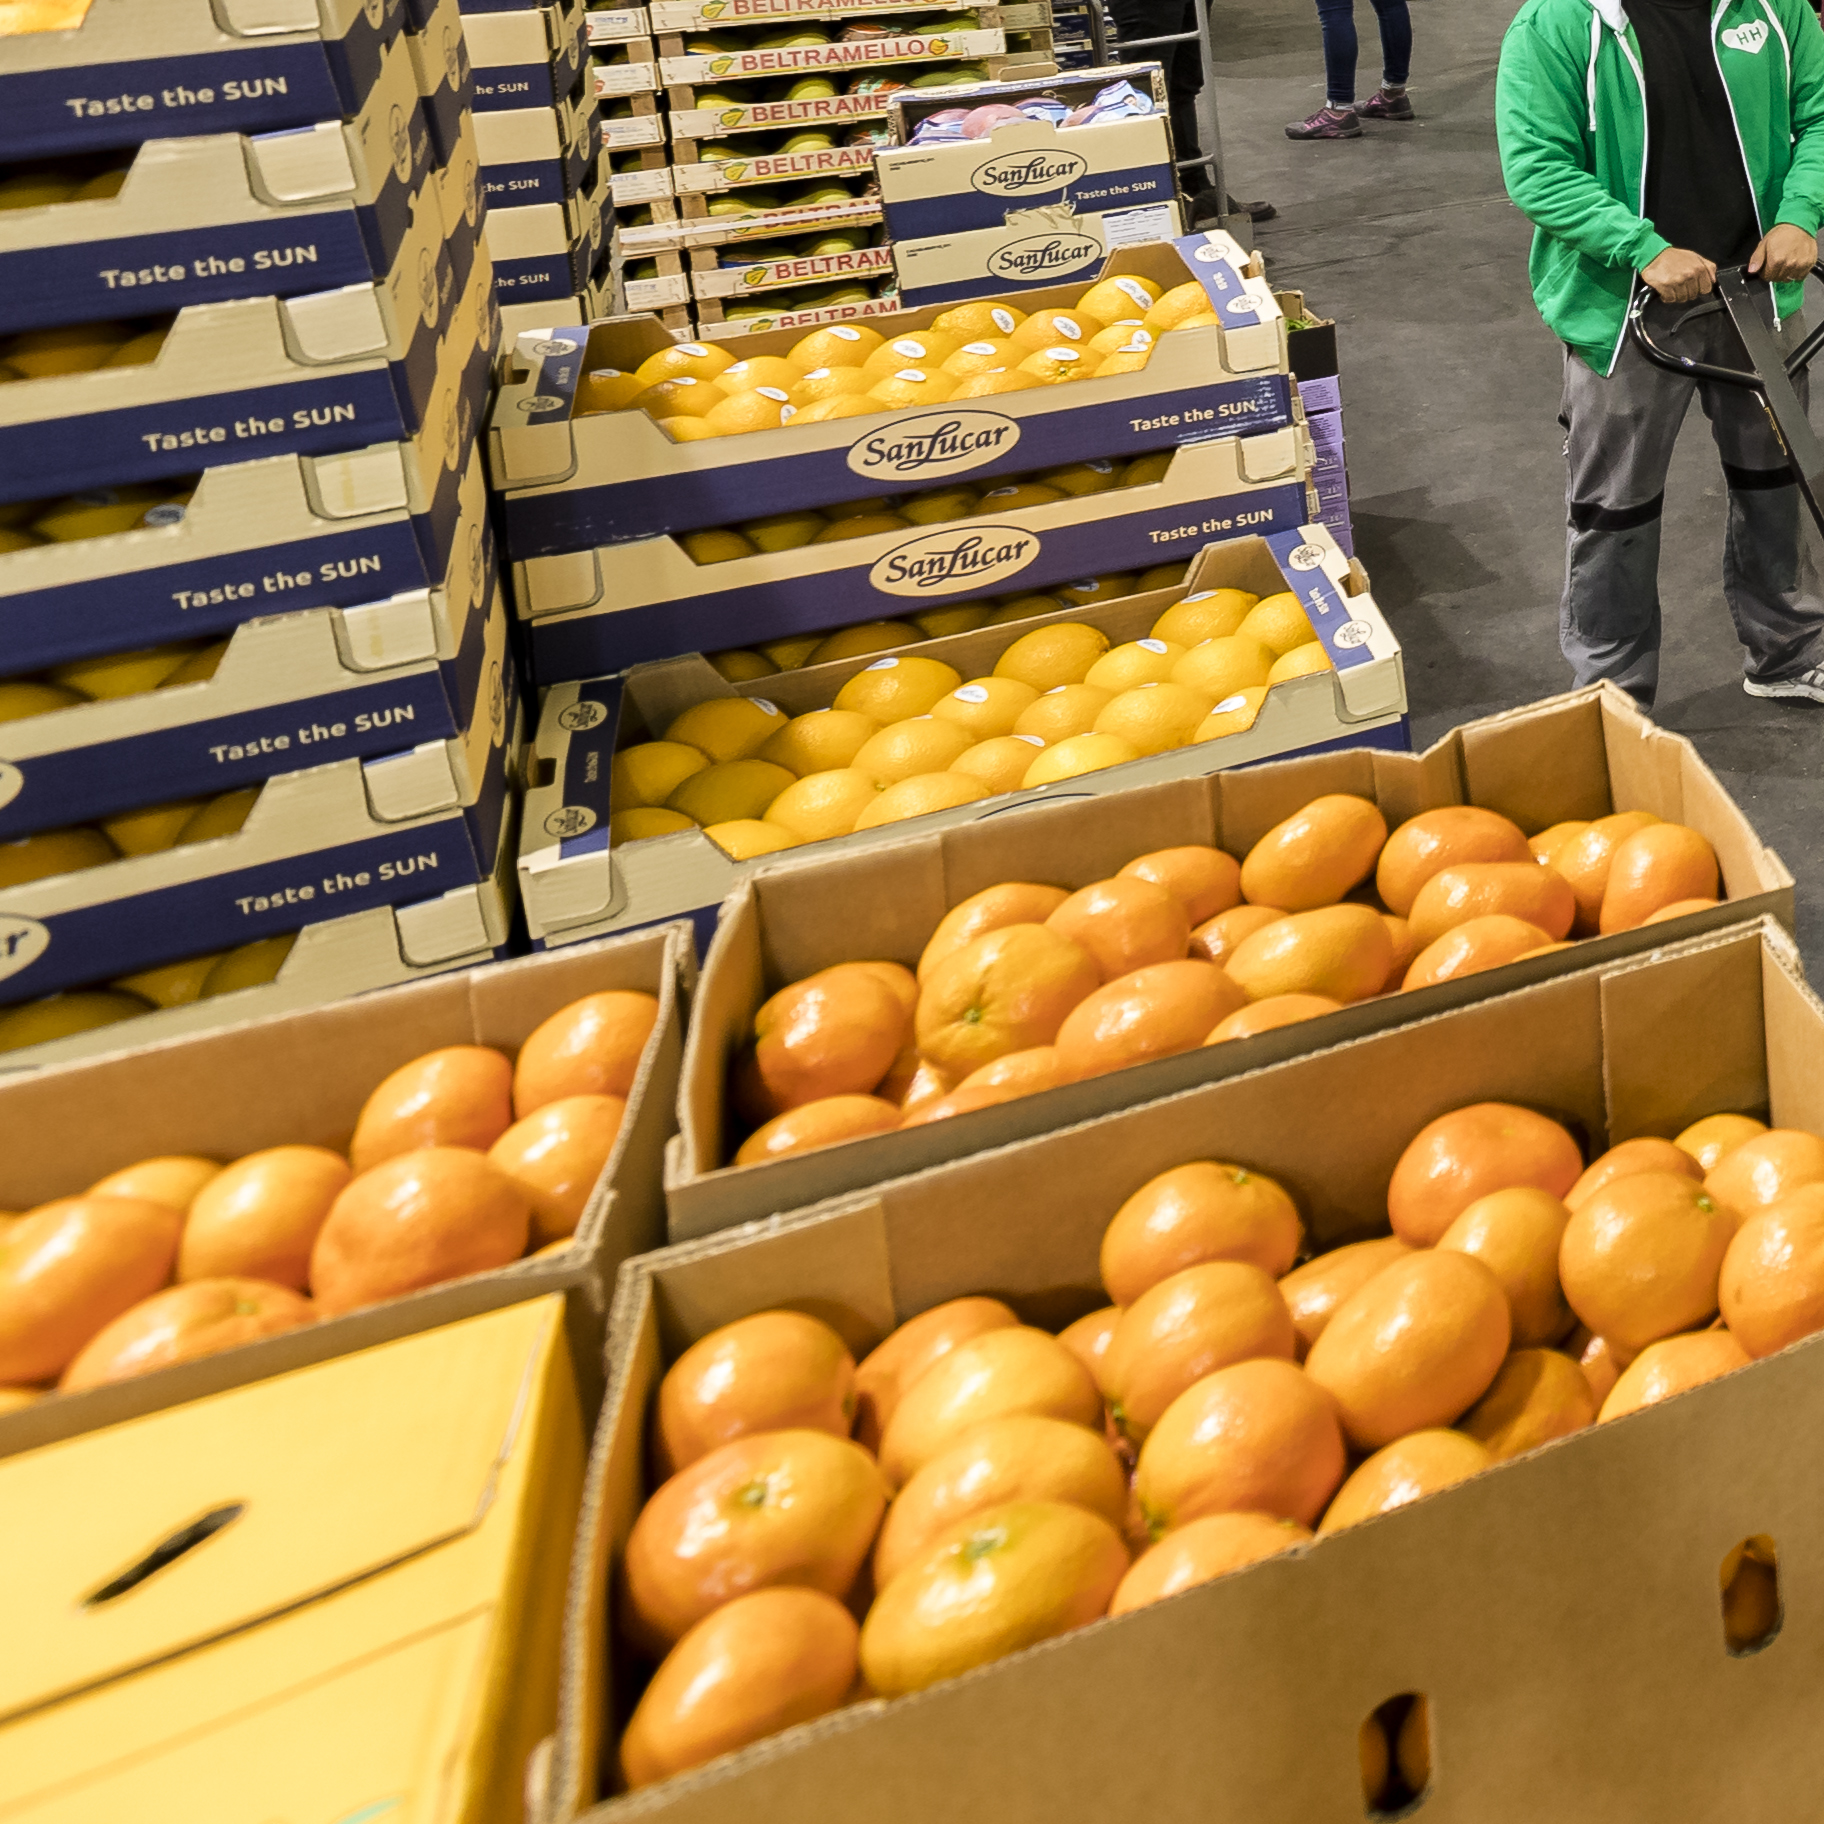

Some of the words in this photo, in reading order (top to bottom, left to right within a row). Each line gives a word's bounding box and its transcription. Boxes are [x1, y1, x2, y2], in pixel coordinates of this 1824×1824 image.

[741, 39, 925, 71] BELTRAMELLO
[67, 92, 154, 119] Taste
[162, 85, 214, 110] the
[222, 76, 287, 102] SUN
[752, 94, 888, 123] BELTRAME
[508, 178, 540, 191] SUN
[983, 156, 1078, 190] SanLucar
[1076, 186, 1107, 201] Taste
[1110, 184, 1127, 198] the
[1130, 179, 1157, 195] SUN
[99, 263, 186, 290] Taste
[193, 254, 245, 277] the
[253, 245, 318, 270] SUN
[999, 240, 1094, 274] SanLucar
[519, 273, 550, 286] SUN
[142, 426, 226, 454] Taste
[234, 415, 284, 439] the
[292, 403, 356, 430] SUN
[1130, 414, 1180, 432] Taste
[1184, 408, 1214, 423] the
[1218, 400, 1256, 417] SUN
[863, 421, 1009, 471] SanLucar
[1149, 526, 1198, 544] Taste
[1202, 518, 1231, 533] the
[1235, 509, 1273, 526] SUN
[884, 537, 1030, 587] SanLucar
[172, 582, 256, 612] Taste
[262, 567, 313, 592] the
[319, 554, 382, 581] SUN
[210, 735, 291, 765] Taste
[298, 720, 348, 745] the
[354, 705, 416, 732] SUN
[236, 886, 315, 917] Taste
[321, 868, 371, 894] the
[378, 852, 438, 878] SUN
